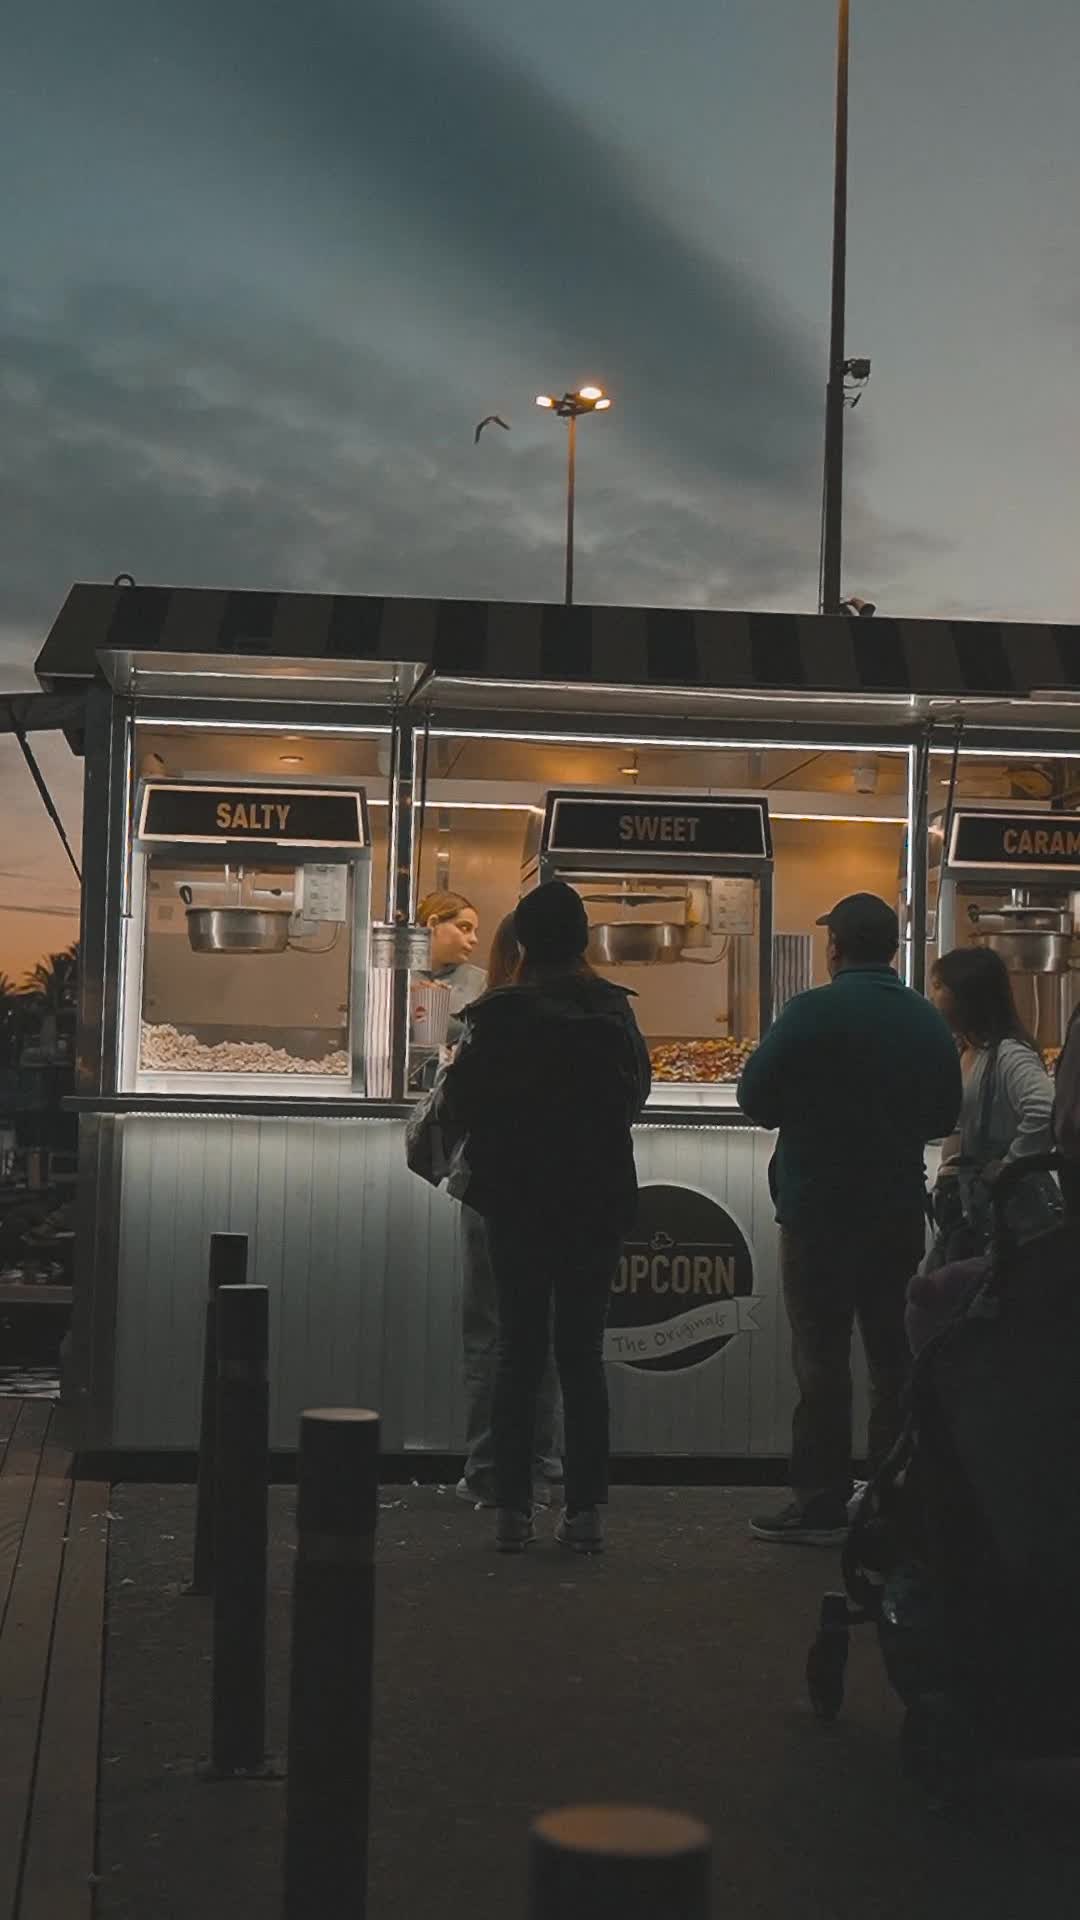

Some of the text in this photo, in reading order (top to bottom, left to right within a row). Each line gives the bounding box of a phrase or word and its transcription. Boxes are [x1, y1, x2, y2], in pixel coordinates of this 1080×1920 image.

[216, 802, 291, 830] SALTY
[618, 814, 700, 842] SWEET
[1003, 829, 1080, 855] CARAM
[611, 1313, 728, 1354] The Originals
